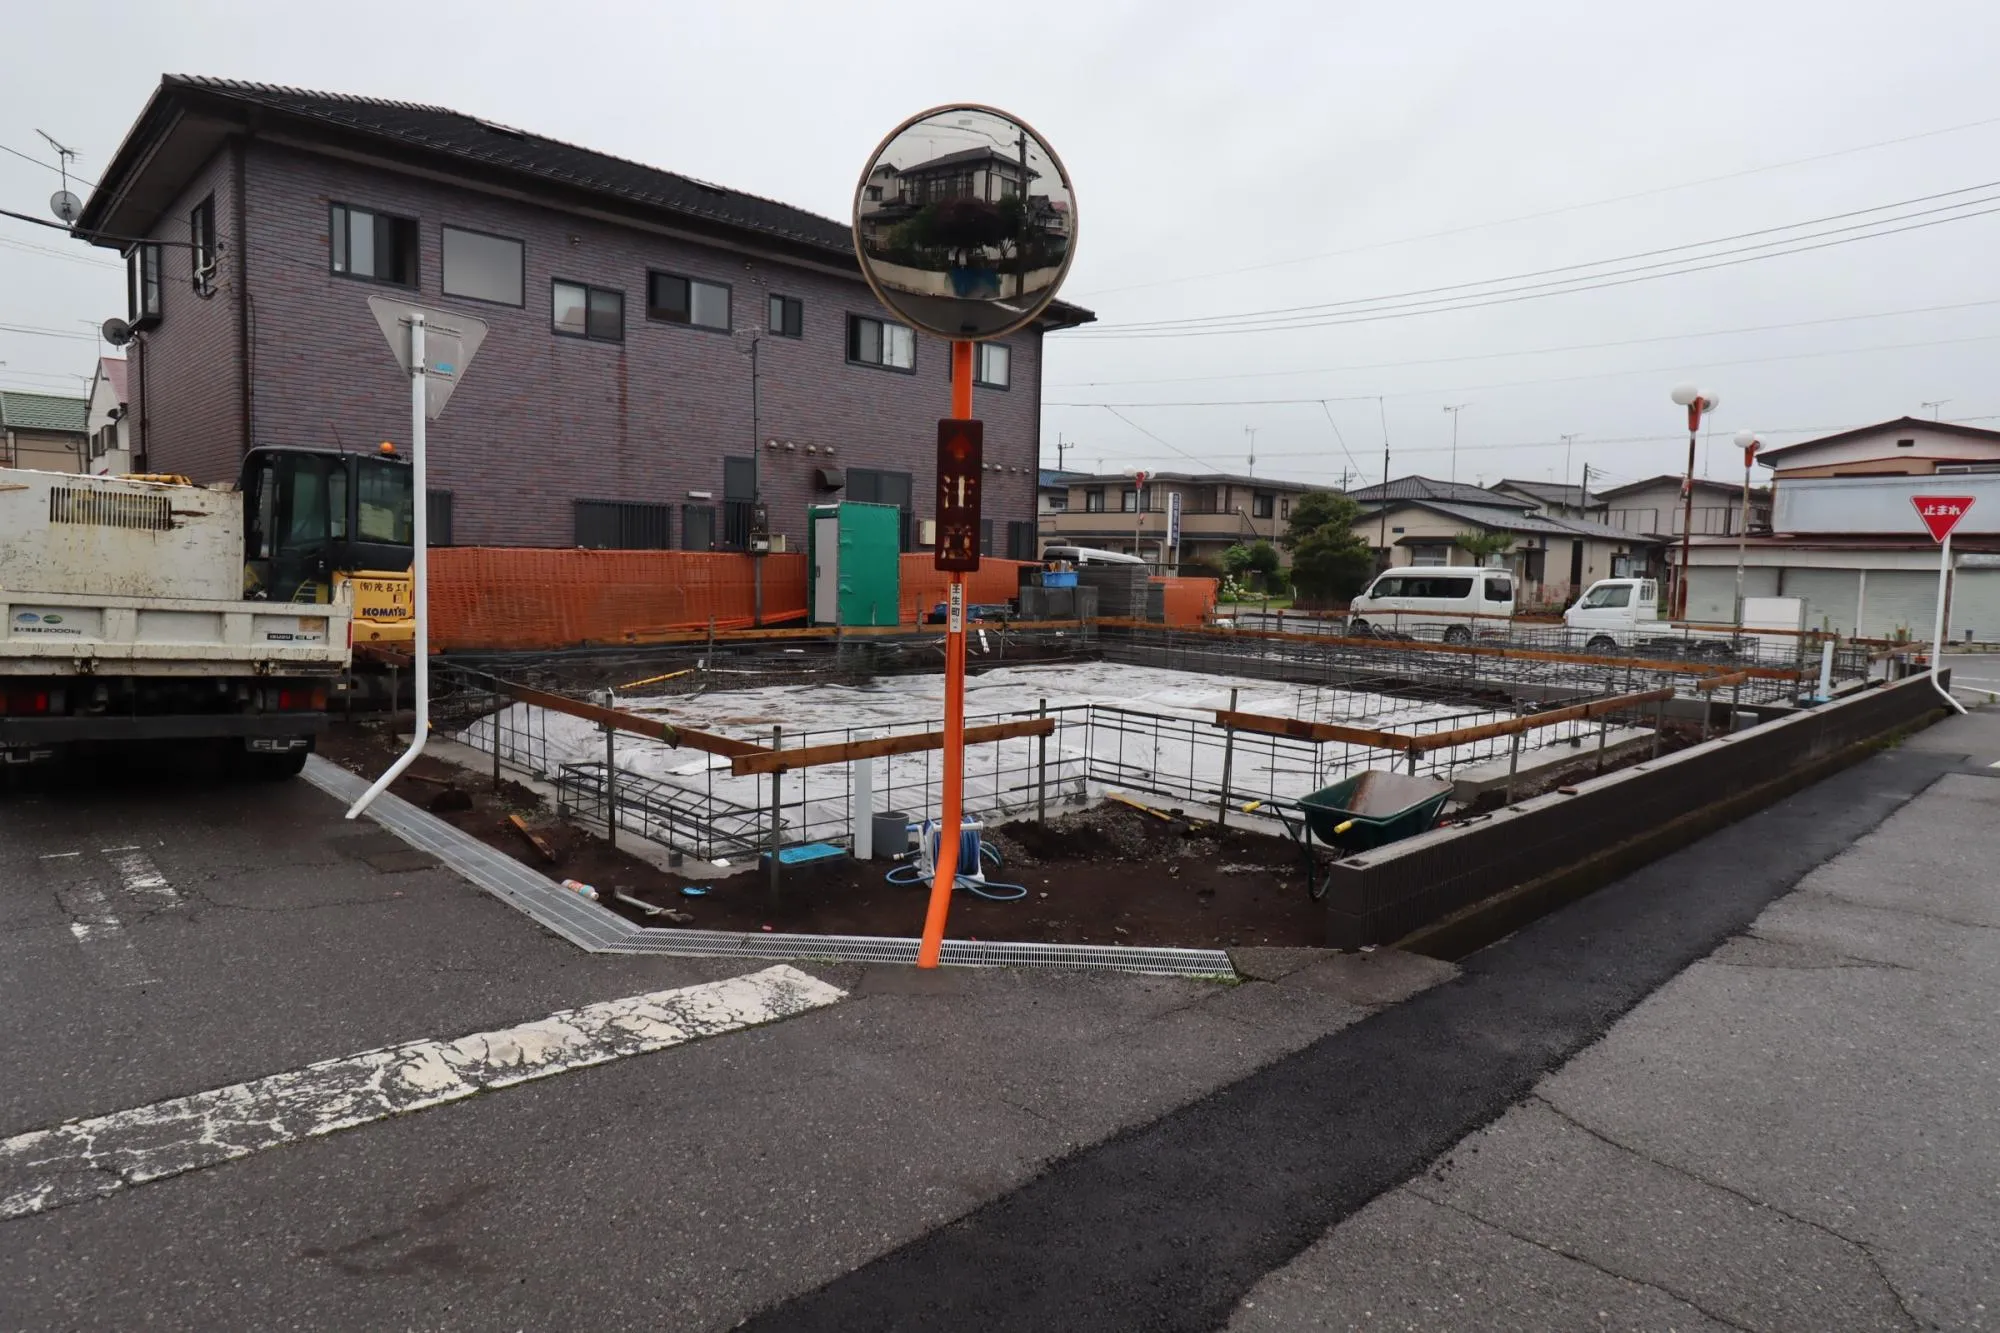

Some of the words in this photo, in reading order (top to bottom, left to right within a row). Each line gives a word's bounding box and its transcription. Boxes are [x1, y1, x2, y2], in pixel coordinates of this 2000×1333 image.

[1923, 504, 1961, 516] 止まれ
[951, 584, 961, 617] 壬生町
[362, 607, 407, 616] KOMATSU
